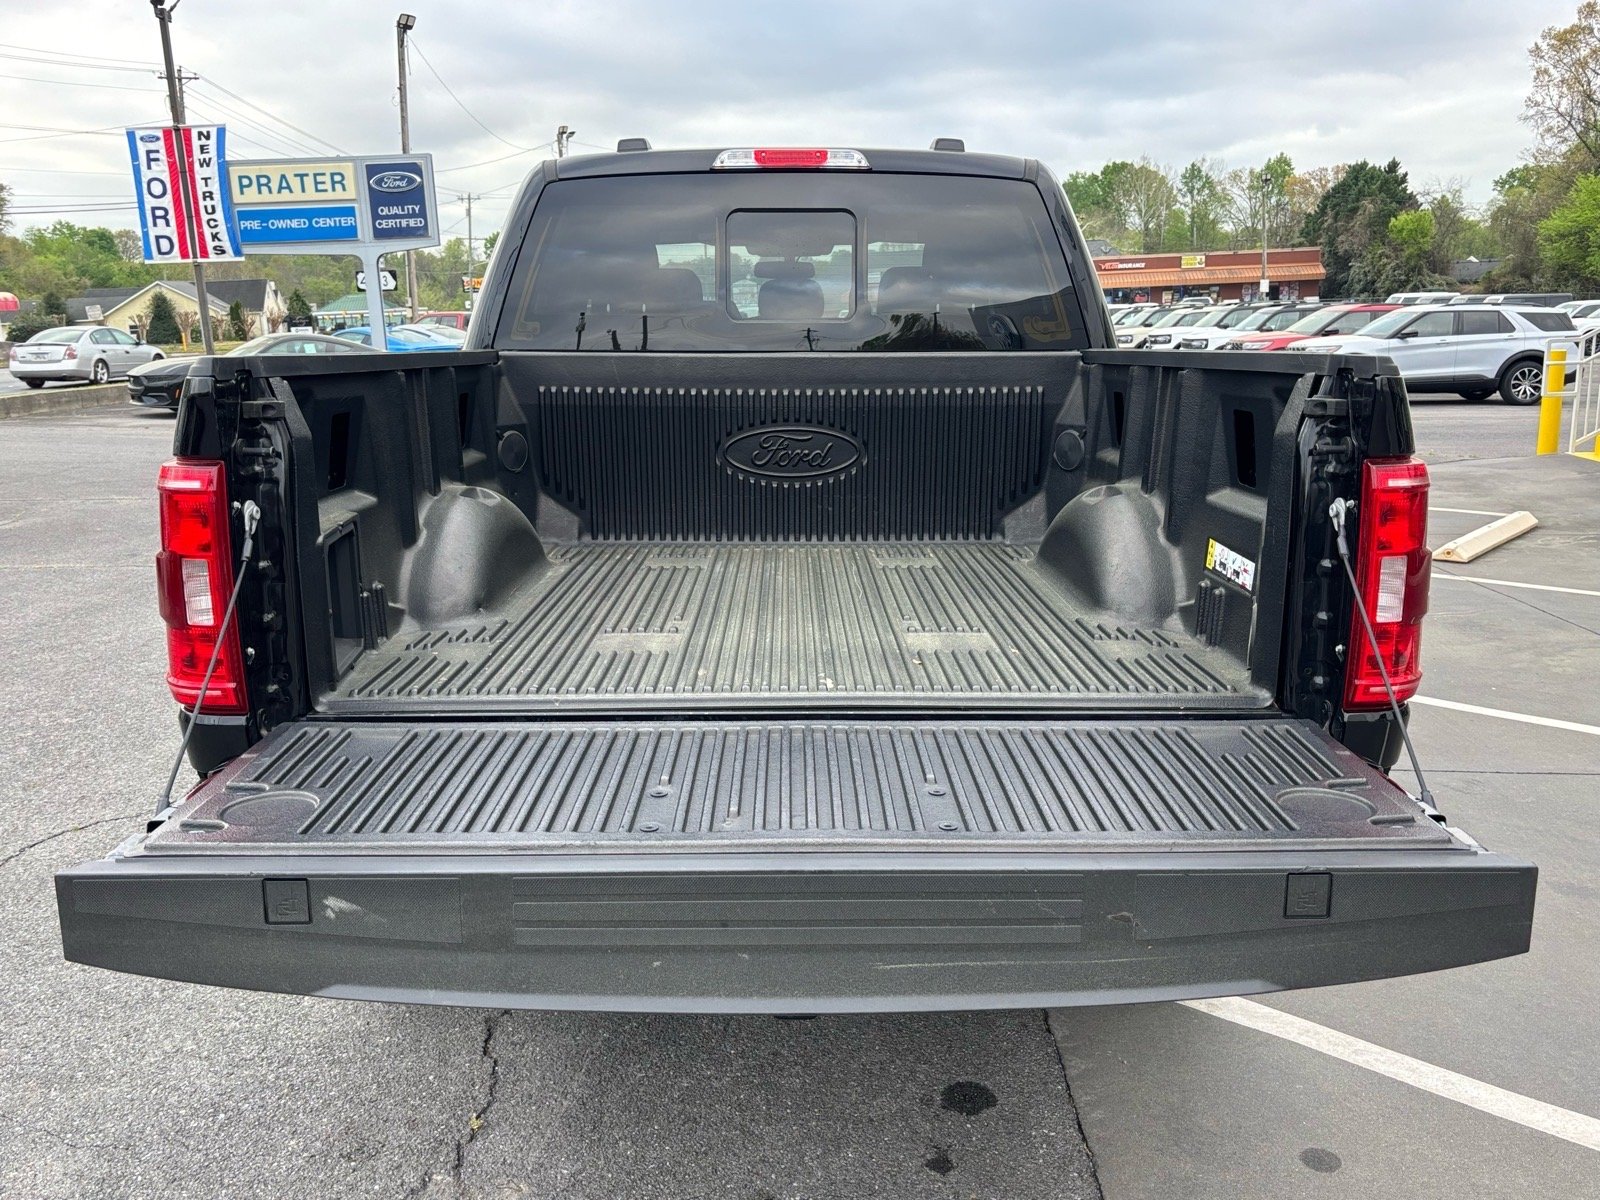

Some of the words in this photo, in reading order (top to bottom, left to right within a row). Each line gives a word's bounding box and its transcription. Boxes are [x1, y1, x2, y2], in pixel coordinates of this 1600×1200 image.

[197, 130, 212, 168] NEW
[237, 172, 347, 195] PRATER
[381, 176, 408, 188] Ford
[145, 149, 175, 256] FORD
[377, 204, 420, 216] QUALITY
[201, 177, 226, 256] TRUCKS
[240, 219, 309, 230] PRE-OWNED
[312, 216, 356, 228] CENTER
[375, 217, 425, 229] CERTIFIED
[360, 275, 389, 287] 43
[751, 434, 833, 468] Ford
